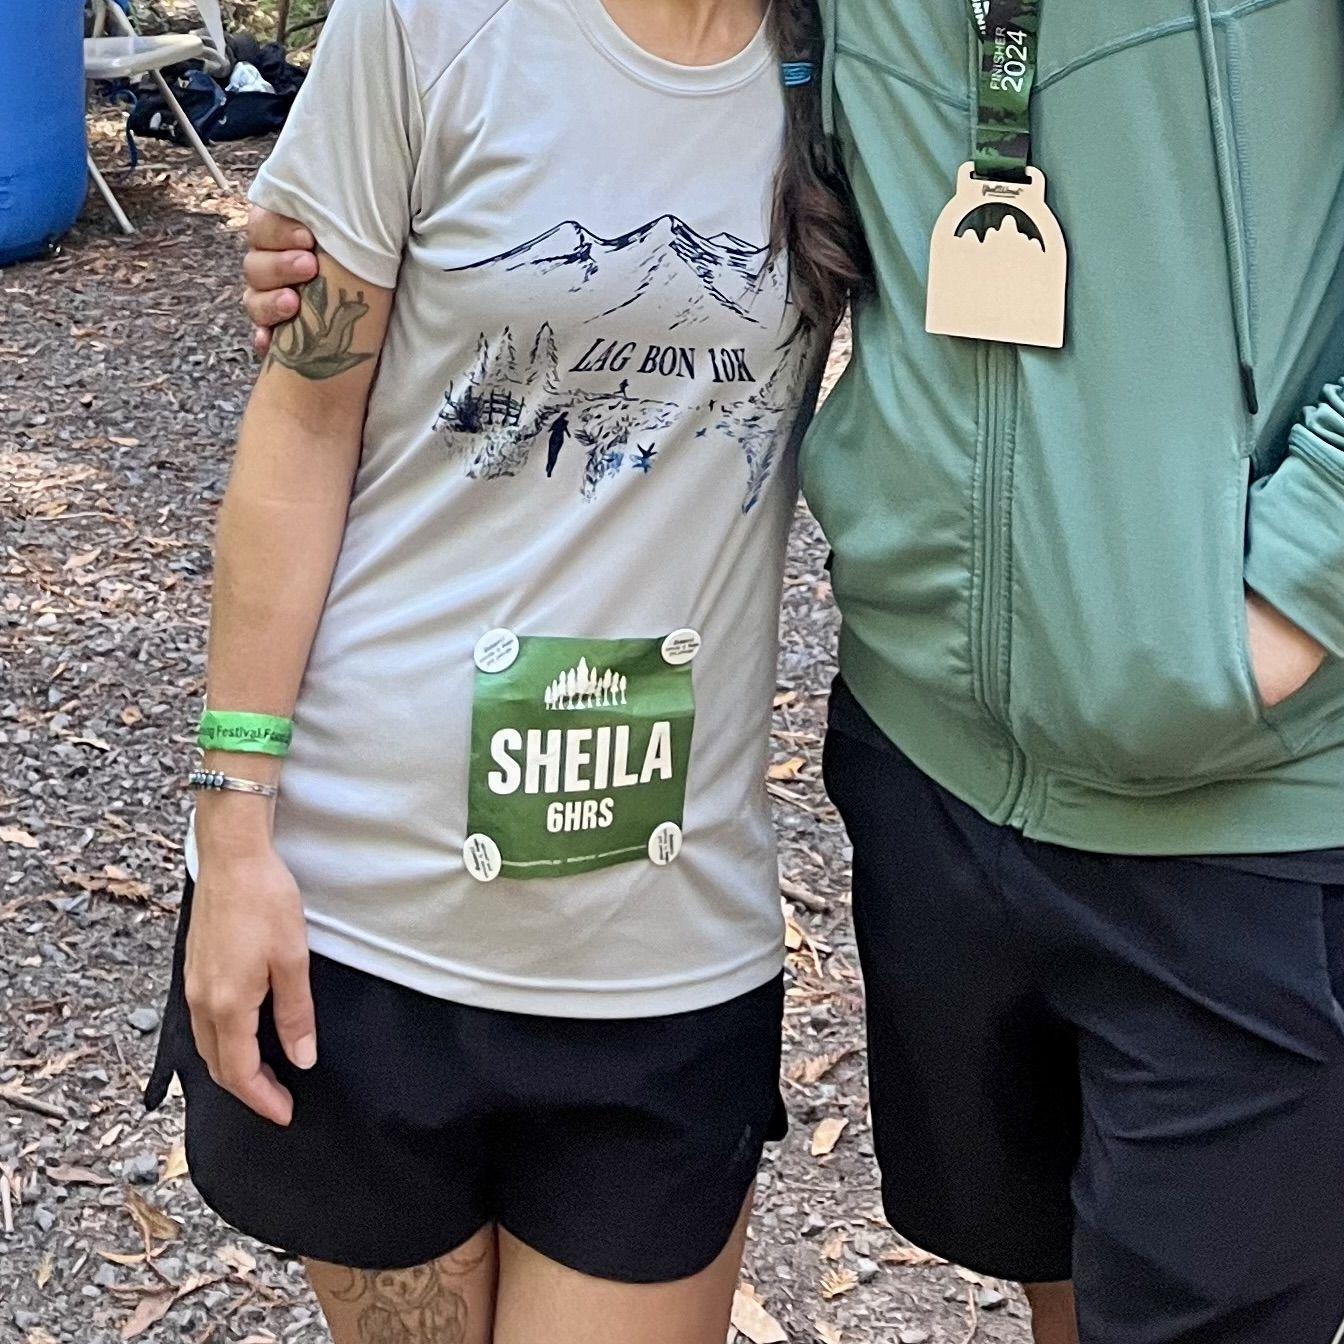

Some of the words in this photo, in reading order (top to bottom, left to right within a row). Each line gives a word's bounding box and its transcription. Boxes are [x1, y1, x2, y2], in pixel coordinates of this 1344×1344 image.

[989, 26, 1007, 91] FINISHER
[1000, 29, 1028, 93] 2024
[569, 338, 637, 372] LAG
[637, 345, 696, 380] BON
[708, 347, 757, 382] 10K
[216, 725, 262, 739] Festival
[487, 721, 673, 795] SHEILA
[546, 797, 615, 832] 6HRS
